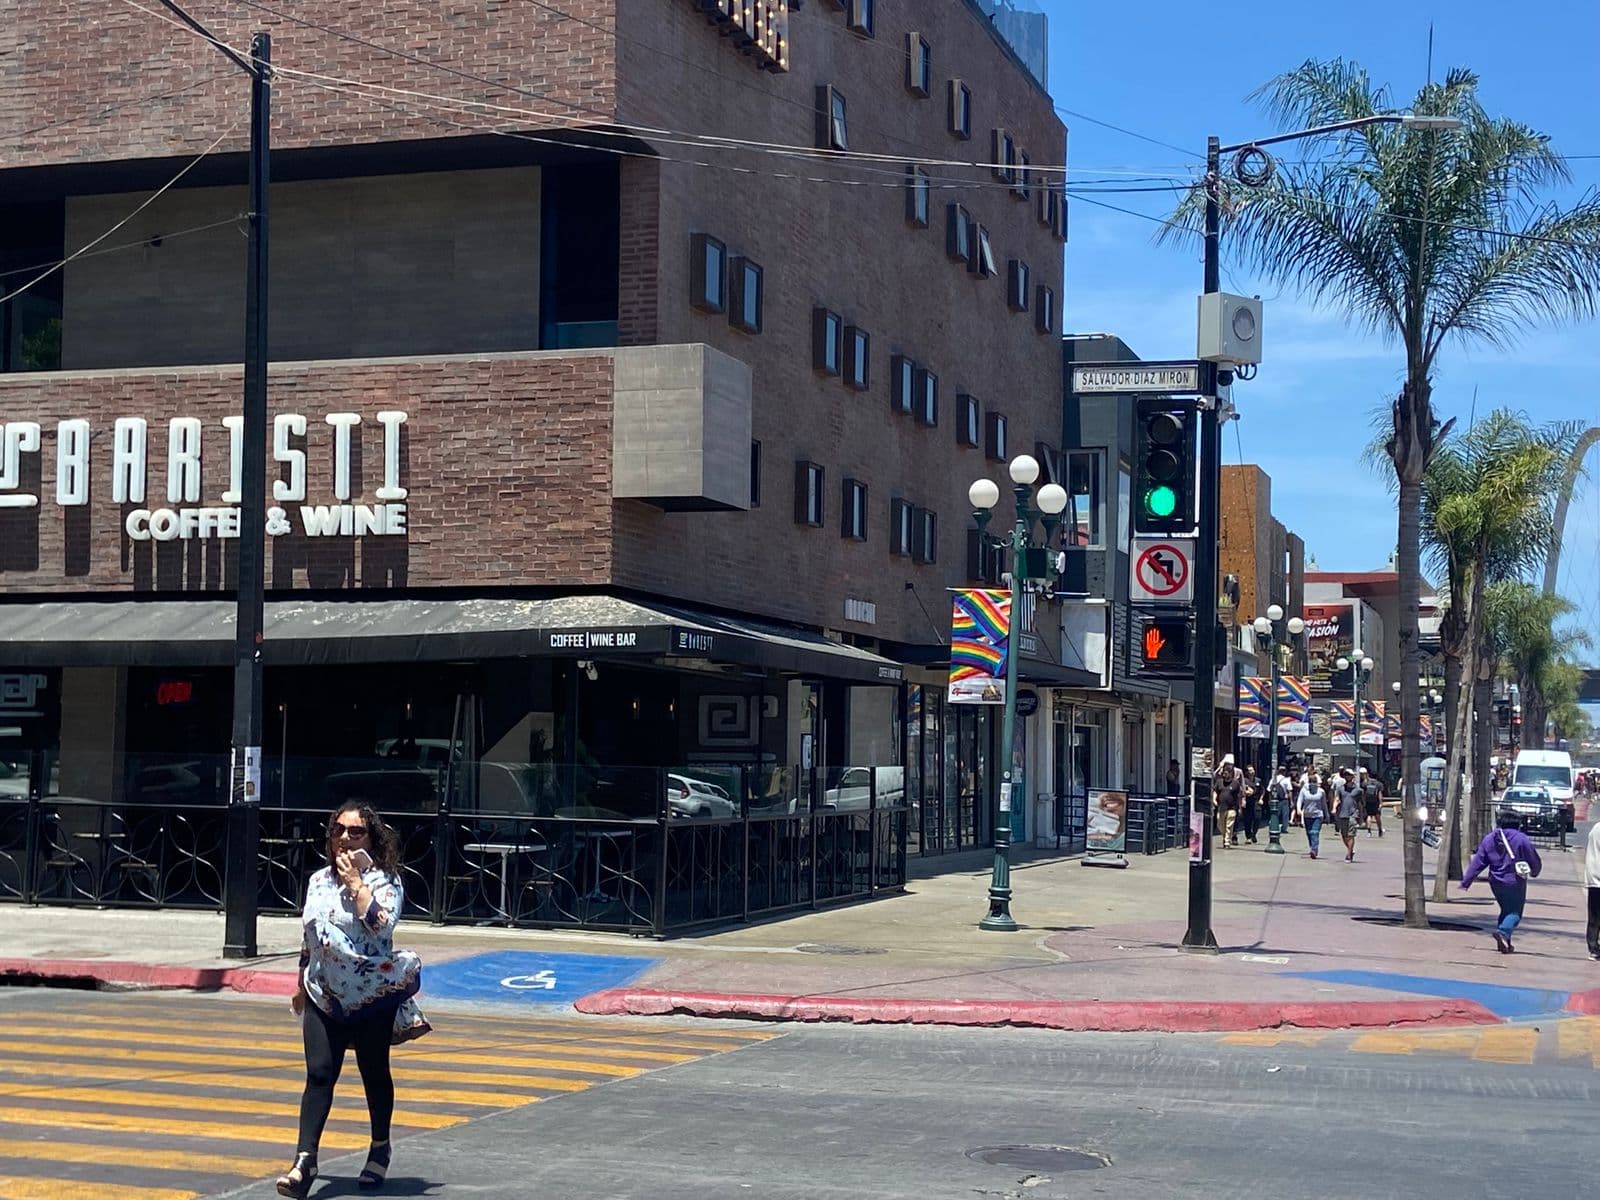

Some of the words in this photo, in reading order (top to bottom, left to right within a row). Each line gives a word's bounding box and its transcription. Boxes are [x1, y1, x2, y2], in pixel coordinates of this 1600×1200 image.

[1081, 373, 1131, 385] SALVADOR
[56, 410, 409, 506] BARISTI
[125, 507, 242, 542] COFFE
[300, 503, 408, 538] WINE
[550, 633, 585, 648] COFFEE
[590, 632, 615, 648] WINE
[616, 632, 637, 647] BAR
